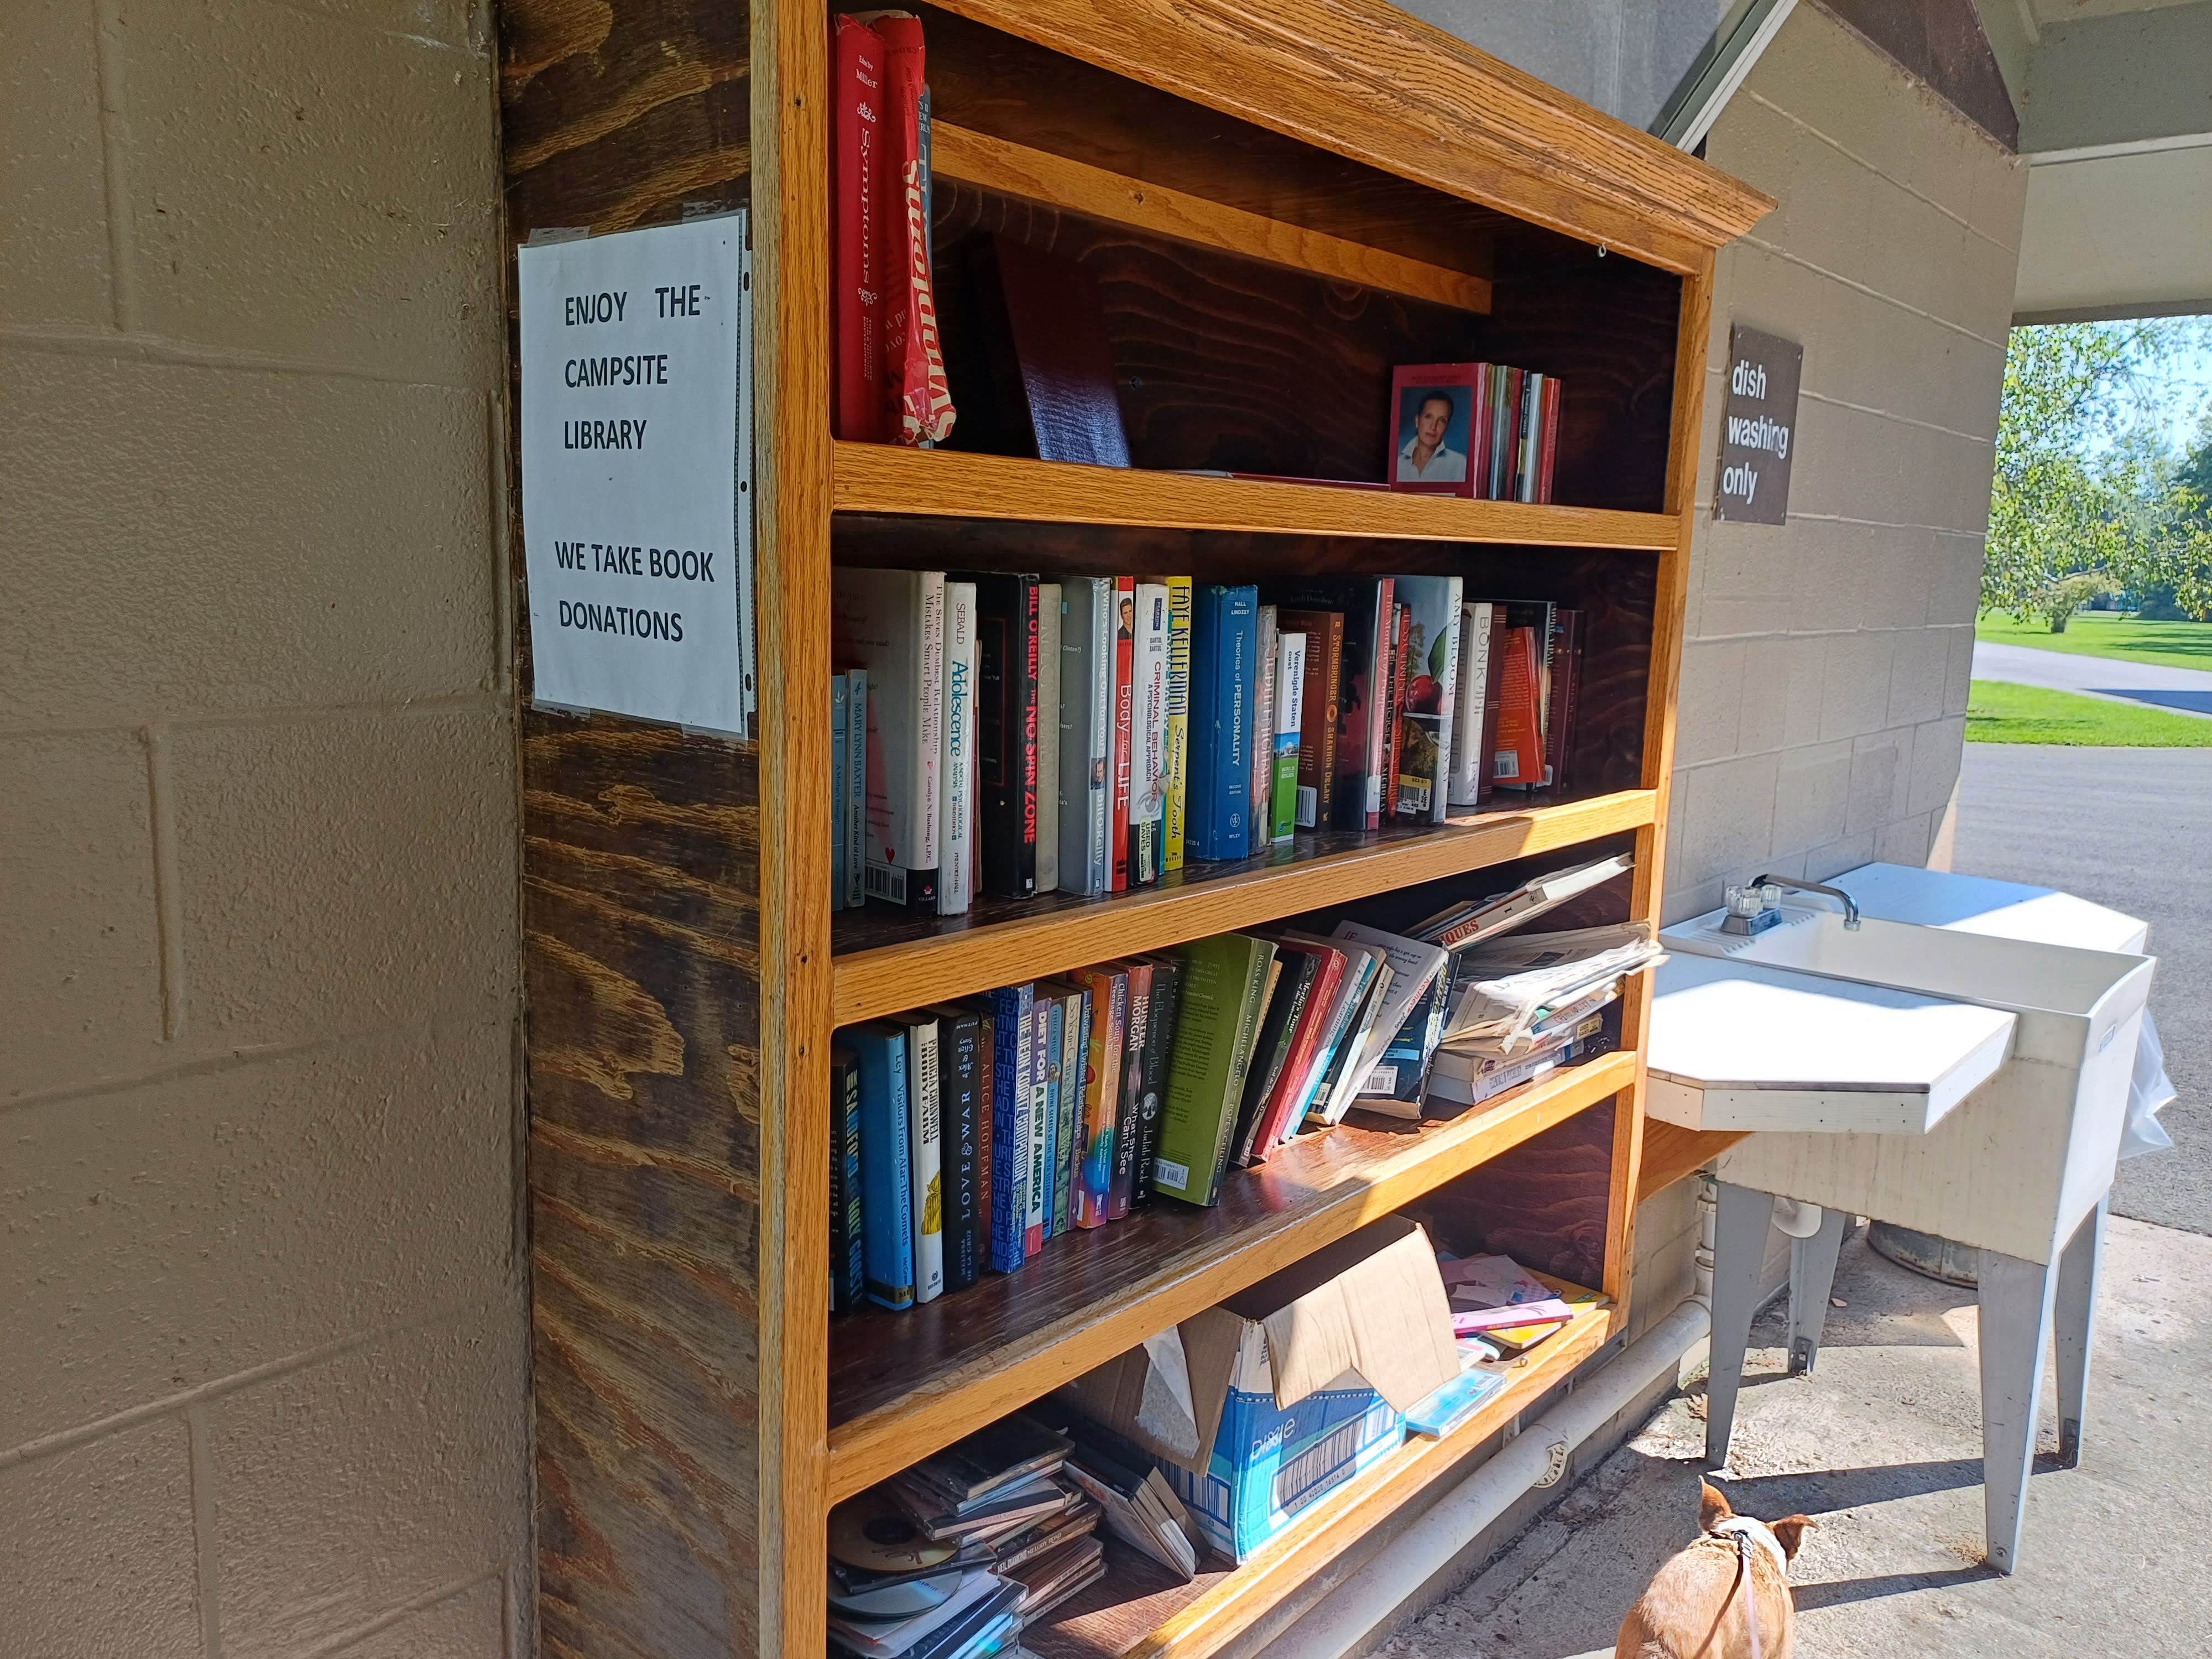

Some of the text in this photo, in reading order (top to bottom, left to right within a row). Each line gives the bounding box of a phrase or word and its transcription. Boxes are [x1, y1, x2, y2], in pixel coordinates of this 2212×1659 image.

[856, 68, 878, 88] Miller
[858, 127, 873, 284] Symptoms
[566, 284, 701, 326] ENJOY THE
[565, 354, 669, 388] CAMPSITE
[1732, 359, 1766, 400] dish
[564, 419, 647, 450] LIBRARY
[1728, 415, 1789, 460] washing
[1723, 462, 1757, 505] only
[555, 540, 714, 582] WE TAKE BOOK
[560, 599, 684, 643] DONATIONS
[1029, 586, 1039, 615] BILL
[1102, 590, 1110, 629] Who's
[956, 603, 966, 645] SEBALD
[1383, 619, 1391, 660] Motion
[1401, 614, 1411, 641] TESS
[1448, 593, 1462, 696] AMY BLOOM
[920, 594, 935, 744] Mistakes Smart People Make
[1028, 619, 1039, 680] O'REILLY
[1099, 630, 1109, 677] Looking
[1168, 585, 1191, 716] FAYE KELLERMAN
[1329, 634, 1341, 702] STORMBRINGER
[1476, 616, 1491, 680] BONK
[1292, 650, 1301, 695] Verenigde
[930, 689, 941, 754] Relationship
[951, 660, 969, 757] Adolescence
[1120, 685, 1132, 731] Body
[1232, 630, 1244, 767] Theories of PERSONALITY
[1026, 706, 1037, 739] NO
[1150, 661, 1161, 802] CRIMINAL BEHAVIOR
[1385, 701, 1393, 743] HORSE
[853, 703, 862, 797] MARY LYNN BAXTER
[1025, 743, 1036, 786] SPIN
[1172, 724, 1184, 790] Serpent's
[1323, 727, 1335, 805] SHANNON DELANY
[1388, 729, 1403, 806] SILENT GIRL
[1117, 762, 1130, 810] LIFE
[1380, 767, 1389, 812] NICHOLAS
[1024, 791, 1036, 843] ZONE
[1171, 796, 1183, 840] Tooth
[1094, 816, 1104, 865] O'Reilly
[1249, 953, 1265, 1004] ROSS KING
[1405, 977, 1431, 1014] Redneck
[956, 1020, 978, 1030] PUTNAM
[1019, 1011, 1033, 1036] THE
[1067, 1003, 1078, 1046] So You're
[1109, 984, 1118, 1020] Teenage
[1129, 995, 1141, 1052] MORGAN
[1138, 995, 1149, 1049] HUNTER
[1288, 979, 1311, 1034] Merlin's Tour
[1328, 999, 1350, 1036] Learning
[1393, 1011, 1406, 1030] Jokes
[958, 1044, 973, 1053] Eliza
[1080, 1004, 1092, 1049] Untwisting
[1110, 983, 1125, 1073] Chicken Soup for the
[1147, 983, 1166, 1085] The Eloquence Blood
[893, 1052, 904, 1074] Ley
[958, 1061, 973, 1071] Alex
[1018, 1037, 1032, 1070] DEAN
[1078, 1052, 1088, 1082] Twisted
[1233, 1014, 1251, 1086] MICHELANGELO
[921, 1047, 931, 1145] BODY FARM
[928, 1039, 940, 1144] PATRICIA CORNWELL
[1016, 1072, 1030, 1110] KOONTZ
[1031, 1011, 1047, 1213] DIET FOR A NEW AMERICA
[1076, 1086, 1087, 1139] Relationships
[846, 1088, 860, 1178] SANDFORD
[980, 1063, 990, 1201] ALICE HOFFMAN
[1130, 1103, 1139, 1136] What
[1141, 1126, 1154, 1157] Judith
[1216, 1103, 1235, 1173] POPE'S CEILING
[897, 1084, 909, 1247] Visitors From Afar: The Comets
[960, 1089, 973, 1219] LOVE & WAR
[1014, 1112, 1027, 1181] COMPANION
[1119, 1116, 1131, 1175] Can't See
[848, 1195, 863, 1294] HOLY GHOST
[1250, 1418, 1296, 1460] Dixie
[997, 1532, 1062, 1573] NEIL DIAMOND MELODY ROAD
